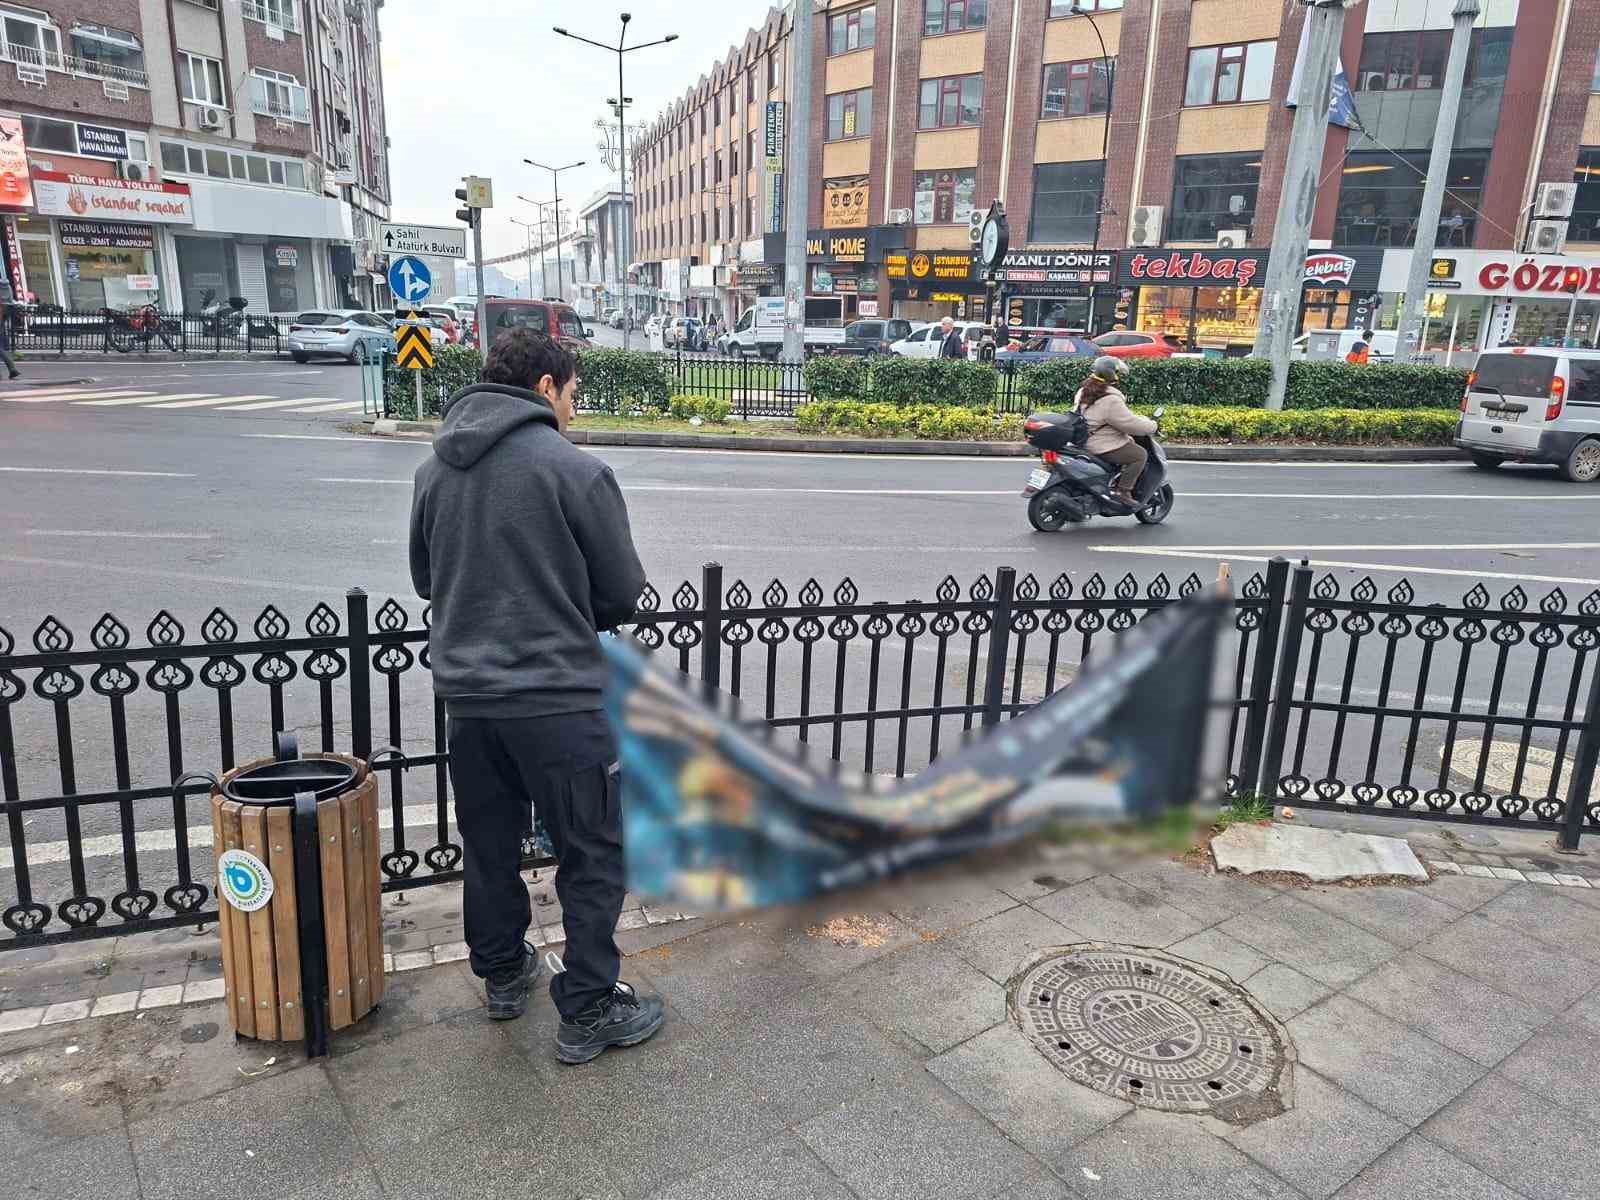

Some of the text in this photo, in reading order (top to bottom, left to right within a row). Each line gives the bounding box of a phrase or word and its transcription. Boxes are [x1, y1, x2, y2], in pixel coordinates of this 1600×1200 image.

[84, 128, 120, 143] İSTANBUL
[80, 142, 127, 155] HAVALİMANI
[68, 174, 163, 192] TÜRK HAVA YOLLARI
[62, 236, 85, 245] GEBZE
[396, 230, 420, 240] Sahil
[397, 240, 463, 254] Atatürk Bulvarı
[806, 237, 866, 255] NAL HOME
[1001, 254, 1050, 266] MANLI
[1130, 252, 1257, 287] tekbaş
